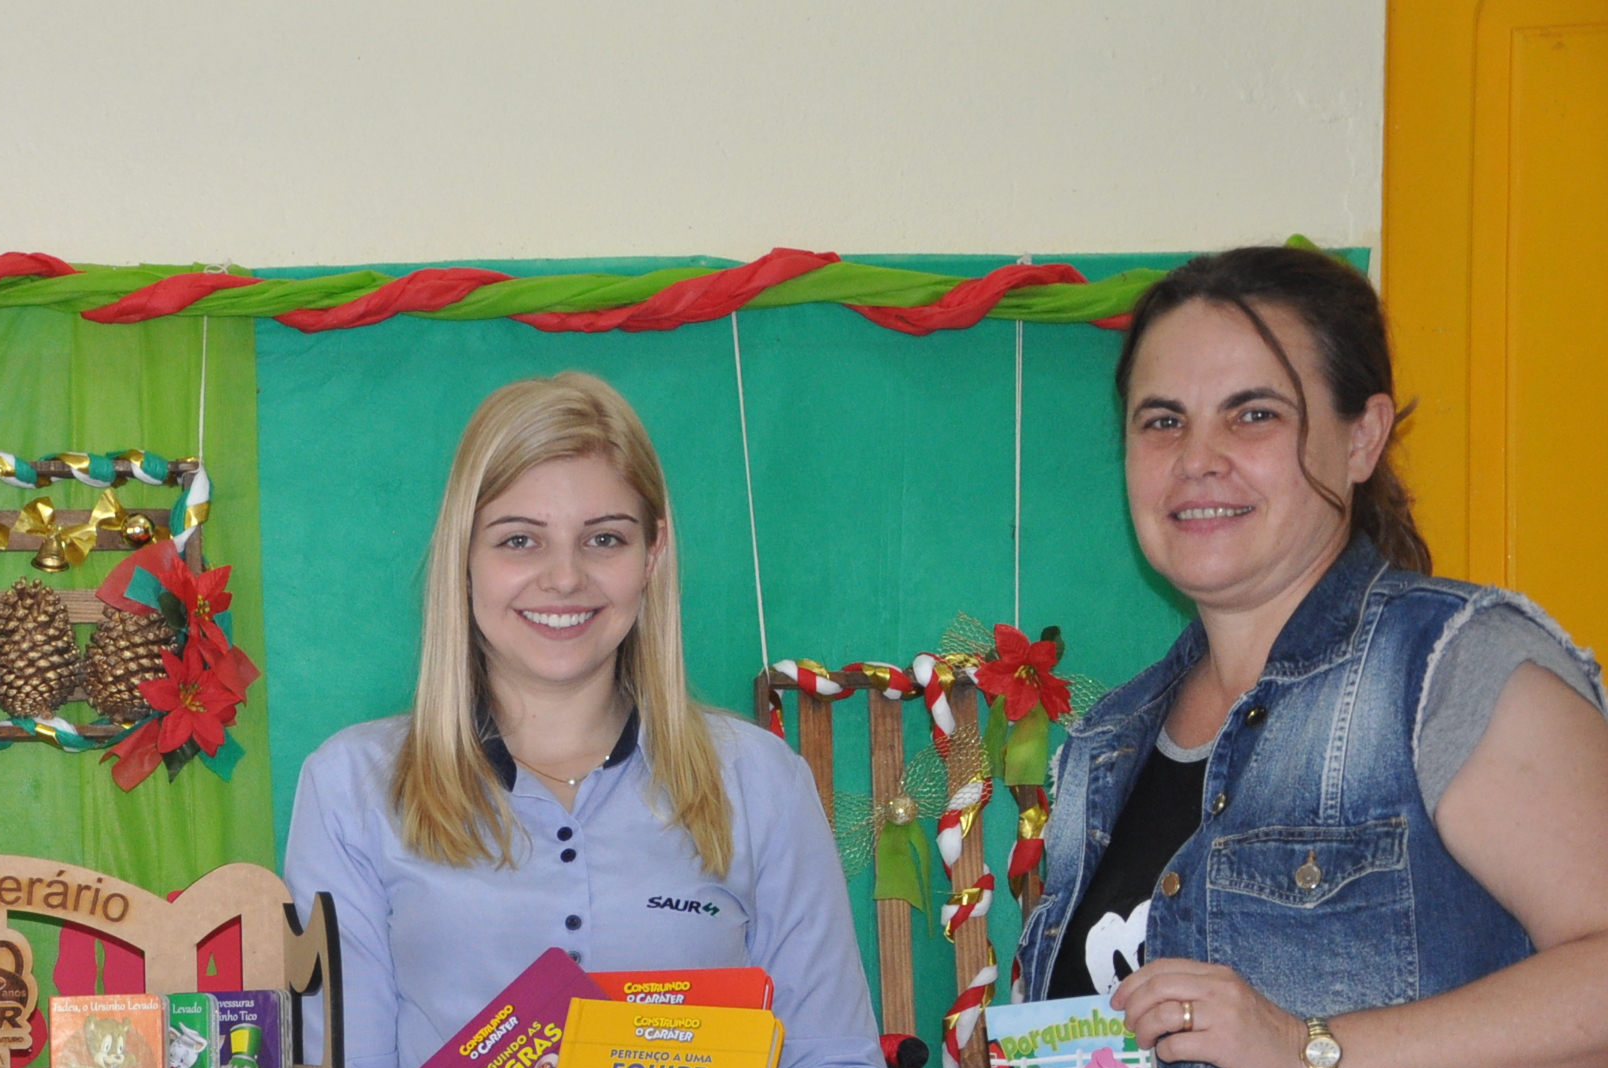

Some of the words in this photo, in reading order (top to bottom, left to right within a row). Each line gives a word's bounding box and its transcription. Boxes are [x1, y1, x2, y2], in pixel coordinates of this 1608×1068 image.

[646, 895, 702, 915] SAUR
[52, 1002, 82, 1013] Tadeu,
[82, 1004, 89, 1012] o
[90, 1000, 126, 1012] Ursinho
[127, 998, 159, 1010] Levado
[172, 1001, 203, 1014] Levado
[219, 1009, 239, 1022] inho
[239, 1010, 258, 1021] Tico
[477, 1016, 520, 1055] CARÁTER
[527, 1021, 542, 1037] AS
[644, 1026, 694, 1042] CARÁTER
[610, 1049, 671, 1062] PERTENÇO
[672, 1053, 683, 1062] A
[685, 1053, 713, 1064] UMA
